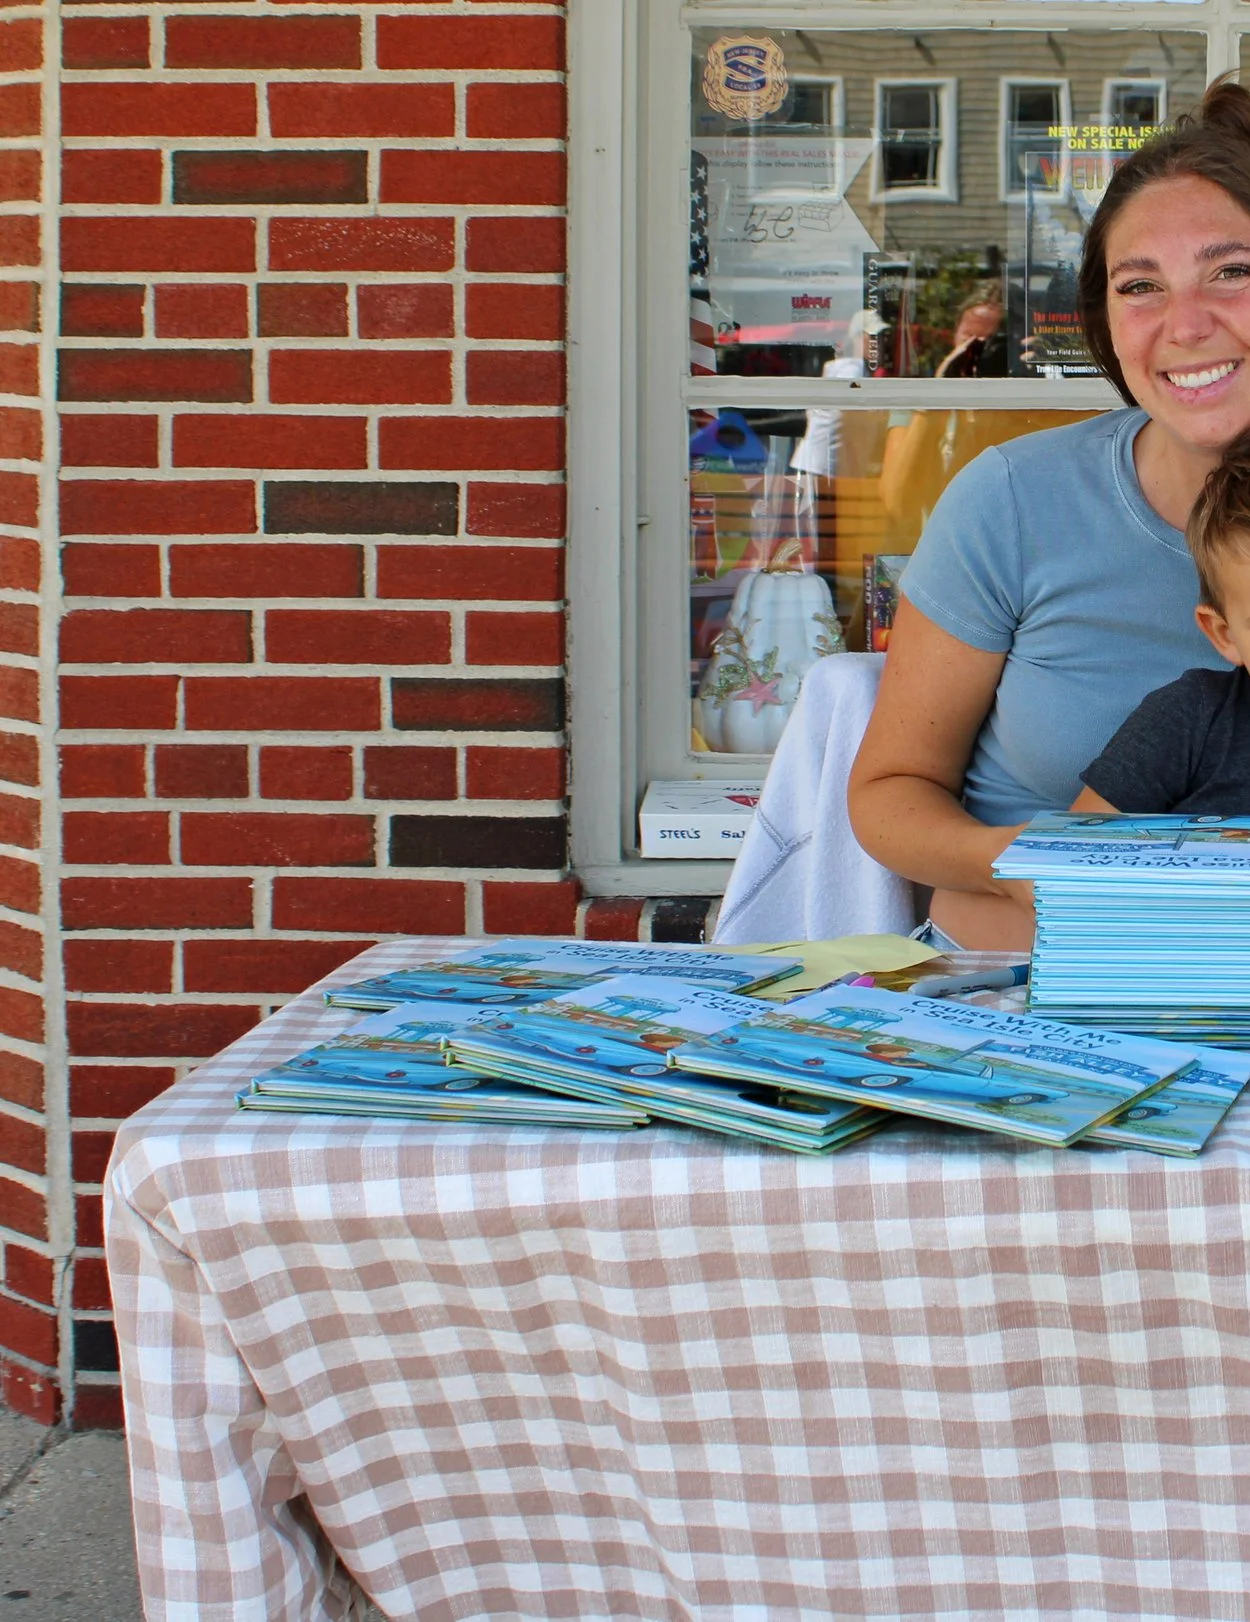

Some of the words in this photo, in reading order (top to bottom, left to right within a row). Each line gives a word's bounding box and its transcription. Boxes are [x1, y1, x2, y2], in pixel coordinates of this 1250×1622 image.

[1048, 126, 1077, 138] NEW
[1082, 126, 1136, 138] SPECIAL
[1067, 138, 1086, 149] ON
[1091, 138, 1124, 149] SALE
[1128, 138, 1145, 149] NO
[868, 259, 879, 370] GUARATEED
[660, 828, 700, 839] STEEL'S
[721, 830, 745, 839] Sal
[1070, 858, 1108, 866] Me
[1081, 853, 1142, 861] City
[1122, 860, 1192, 868] With
[560, 944, 630, 955] Cruise
[634, 948, 690, 959] With
[705, 952, 735, 962] Me
[566, 950, 609, 958] Sea
[616, 953, 658, 962] Isle
[664, 957, 719, 966] City
[677, 997, 697, 1005] in
[702, 1001, 753, 1017] Sea
[692, 991, 776, 1012] Cruise
[898, 1006, 916, 1014] in
[922, 1010, 975, 1025] Sea
[983, 1020, 1034, 1036] Isle
[1042, 1031, 1106, 1050] City
[911, 999, 997, 1020] Cruise
[1005, 1015, 1072, 1036] With
[1074, 1031, 1124, 1046] Me
